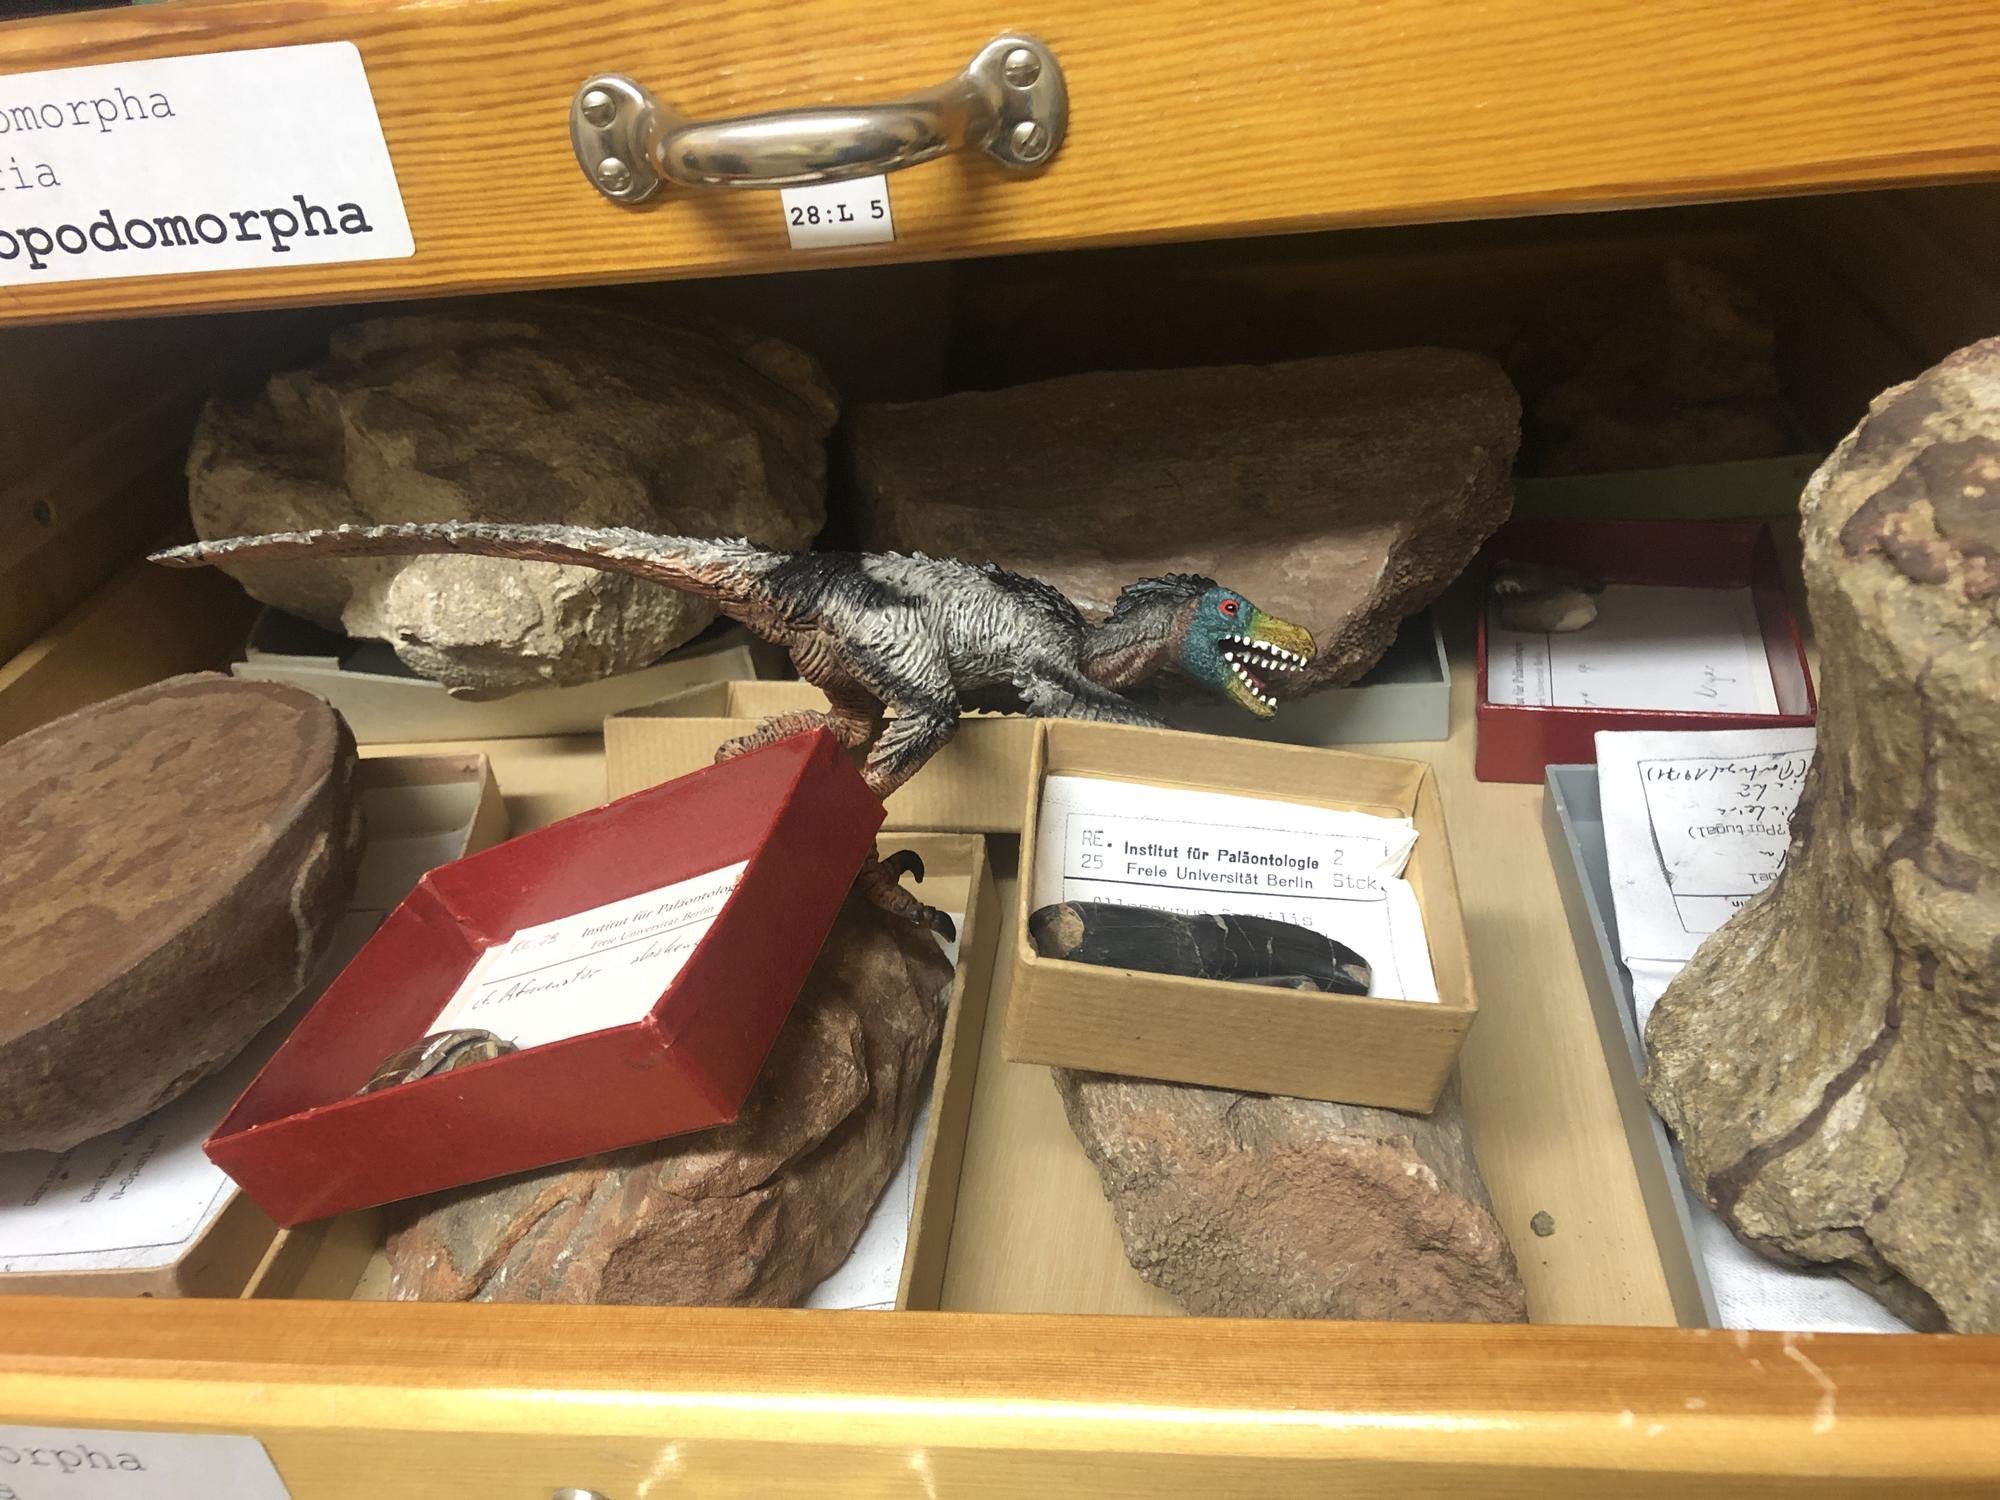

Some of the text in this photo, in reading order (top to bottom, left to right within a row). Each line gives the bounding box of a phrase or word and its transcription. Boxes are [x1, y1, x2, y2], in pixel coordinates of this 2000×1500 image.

[0, 156, 62, 191] ia
[790, 199, 884, 226] 28:L 5
[0, 195, 373, 270] opodomorpha
[1081, 853, 1104, 870] 25
[1124, 840, 1320, 871] Institut für Paläontologie
[1126, 862, 1314, 890] Freie Universität Berlin
[581, 916, 630, 938] Institut
[632, 908, 654, 923] für
[681, 905, 715, 922] Berlin
